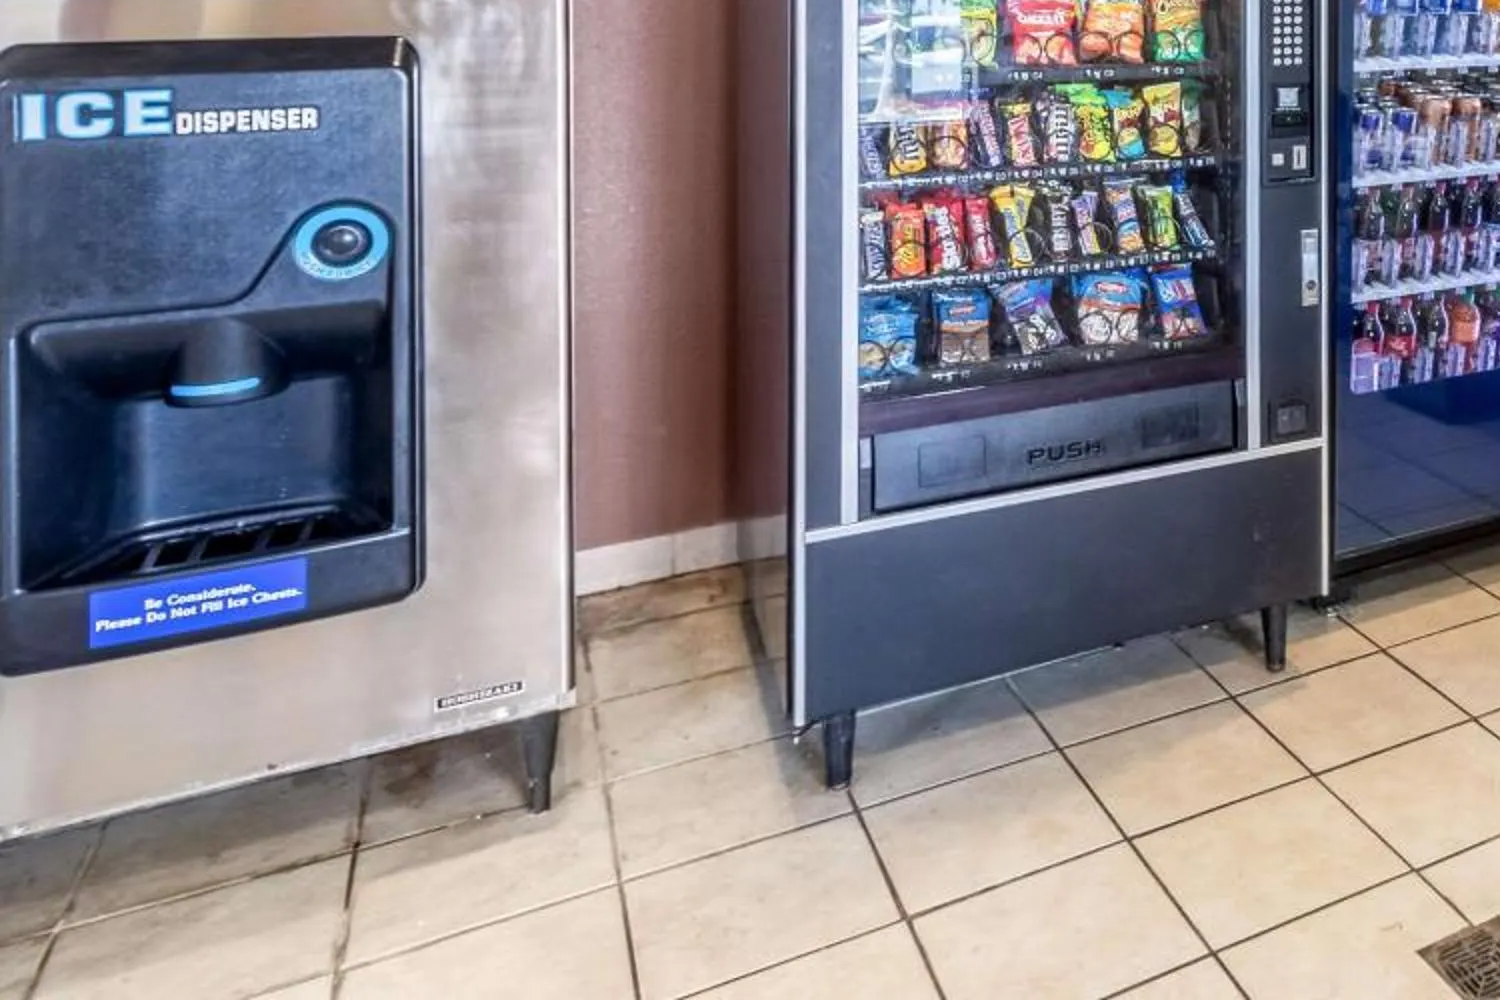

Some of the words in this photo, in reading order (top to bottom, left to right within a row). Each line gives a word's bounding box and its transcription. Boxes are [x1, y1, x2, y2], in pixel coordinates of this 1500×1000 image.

[21, 89, 172, 140] ICE
[175, 107, 319, 135] DISPENSER
[1027, 440, 1106, 465] PUSH
[95, 615, 141, 632] Please
[147, 611, 166, 623] Do
[170, 606, 197, 619] Not
[228, 596, 249, 609] Ice
[144, 598, 163, 611] Be
